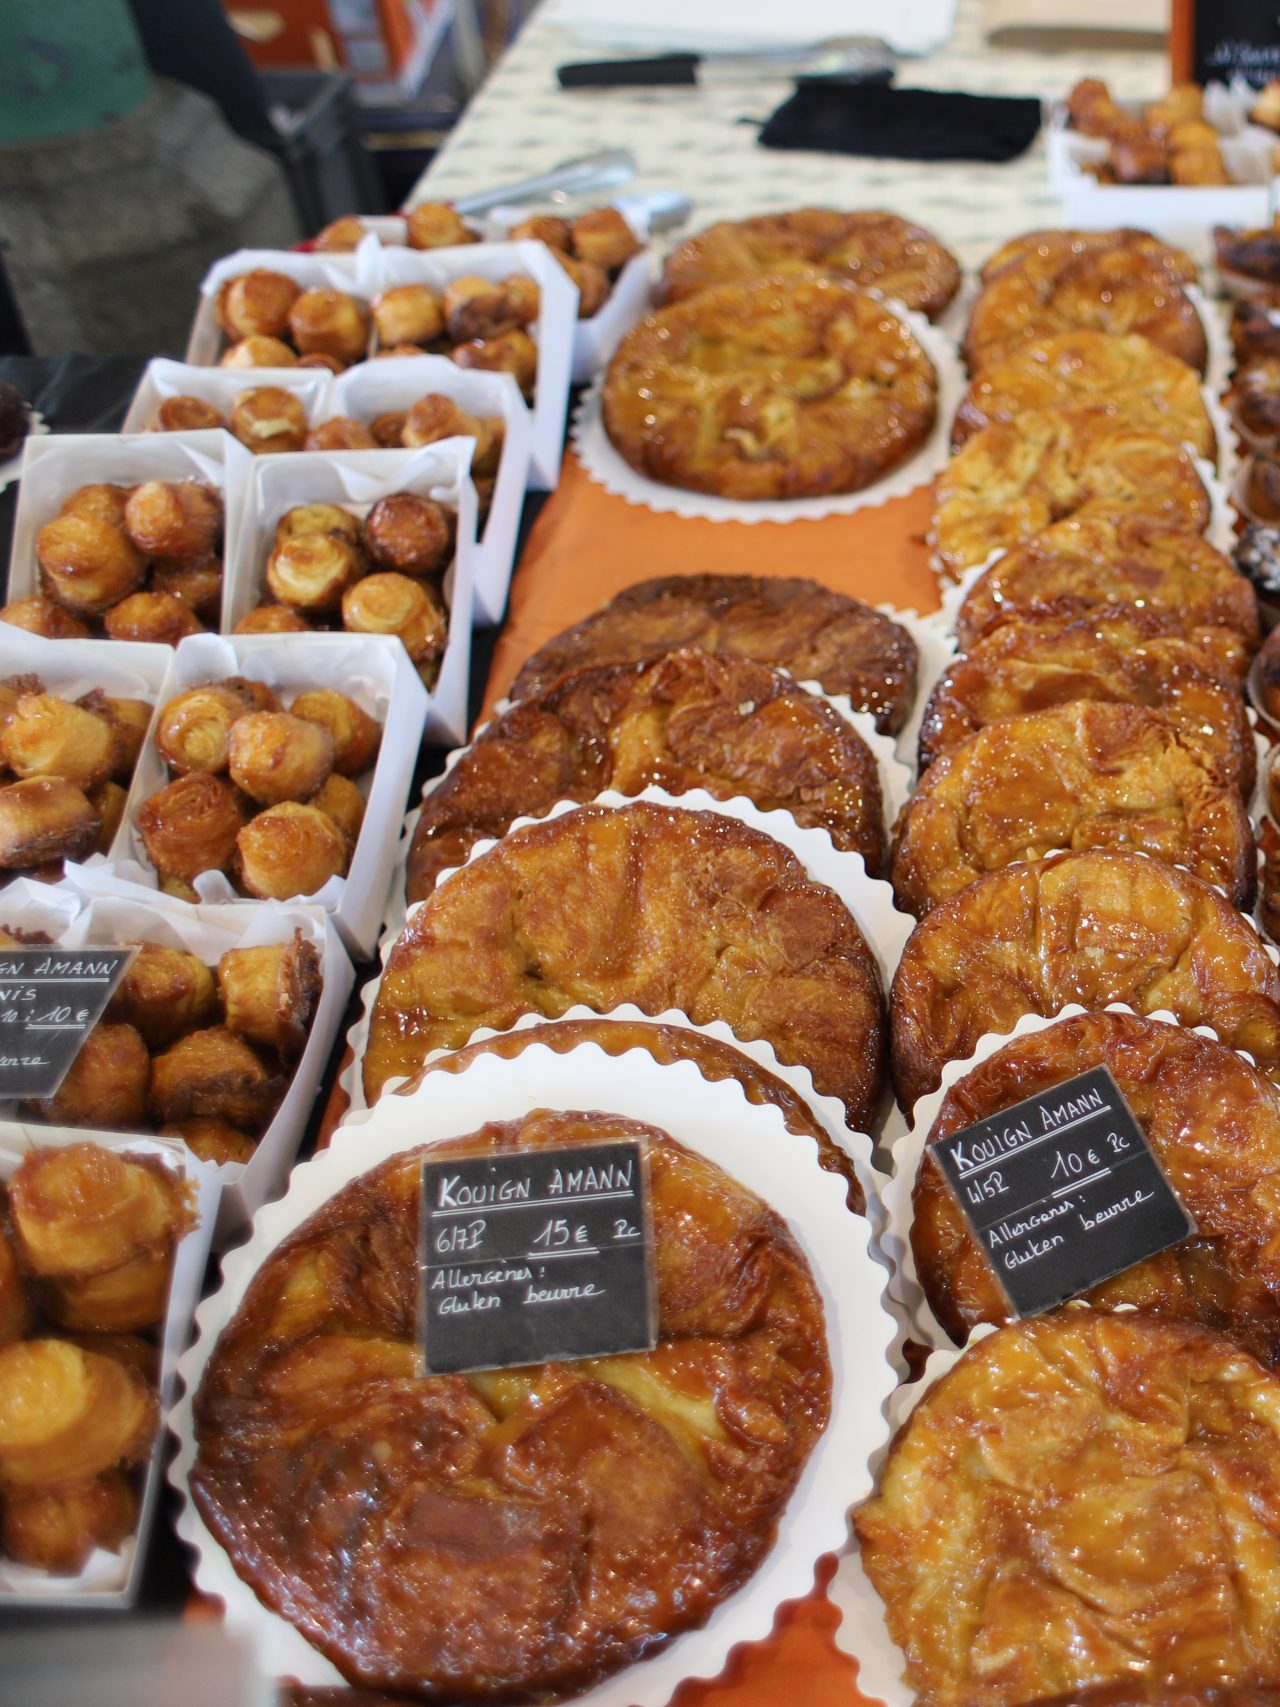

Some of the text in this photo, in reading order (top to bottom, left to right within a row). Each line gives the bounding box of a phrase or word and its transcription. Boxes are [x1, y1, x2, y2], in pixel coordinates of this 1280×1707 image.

[34, 957, 118, 975] AMANN
[950, 1087, 1103, 1171] KOUIGN AMANN
[440, 1160, 633, 1208] KOUIGN AMANN
[1004, 1189, 1155, 1270] Gluten beurre
[439, 1283, 606, 1315] Gluten beurre
